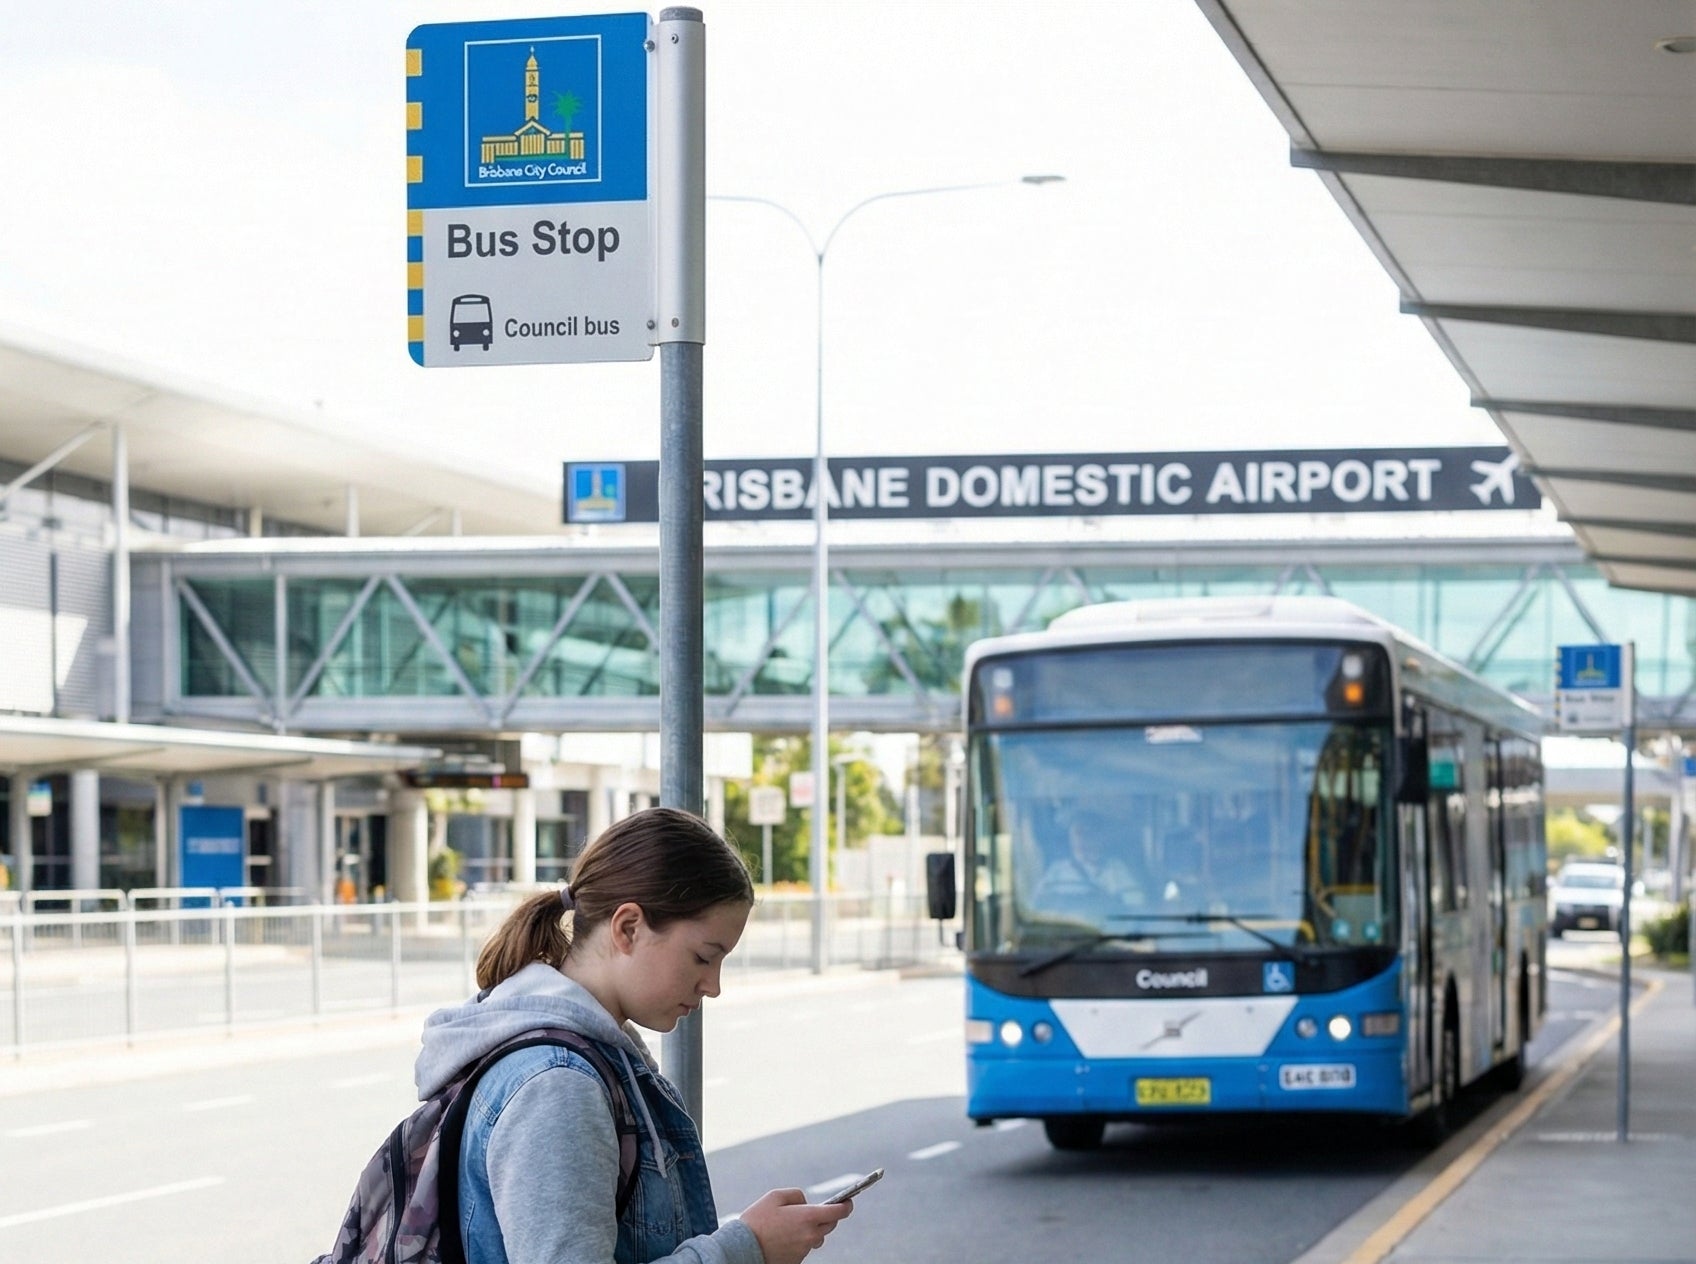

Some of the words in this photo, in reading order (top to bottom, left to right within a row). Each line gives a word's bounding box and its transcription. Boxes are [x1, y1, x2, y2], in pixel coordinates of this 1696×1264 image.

[448, 223, 519, 258] Bus
[532, 220, 620, 262] Stop
[505, 316, 578, 337] Council
[584, 316, 620, 336] bus
[703, 467, 909, 510] RISBANE
[926, 462, 1193, 508] DOMESTIC
[1205, 458, 1442, 503] AIRPORT
[1136, 967, 1208, 989] Council
